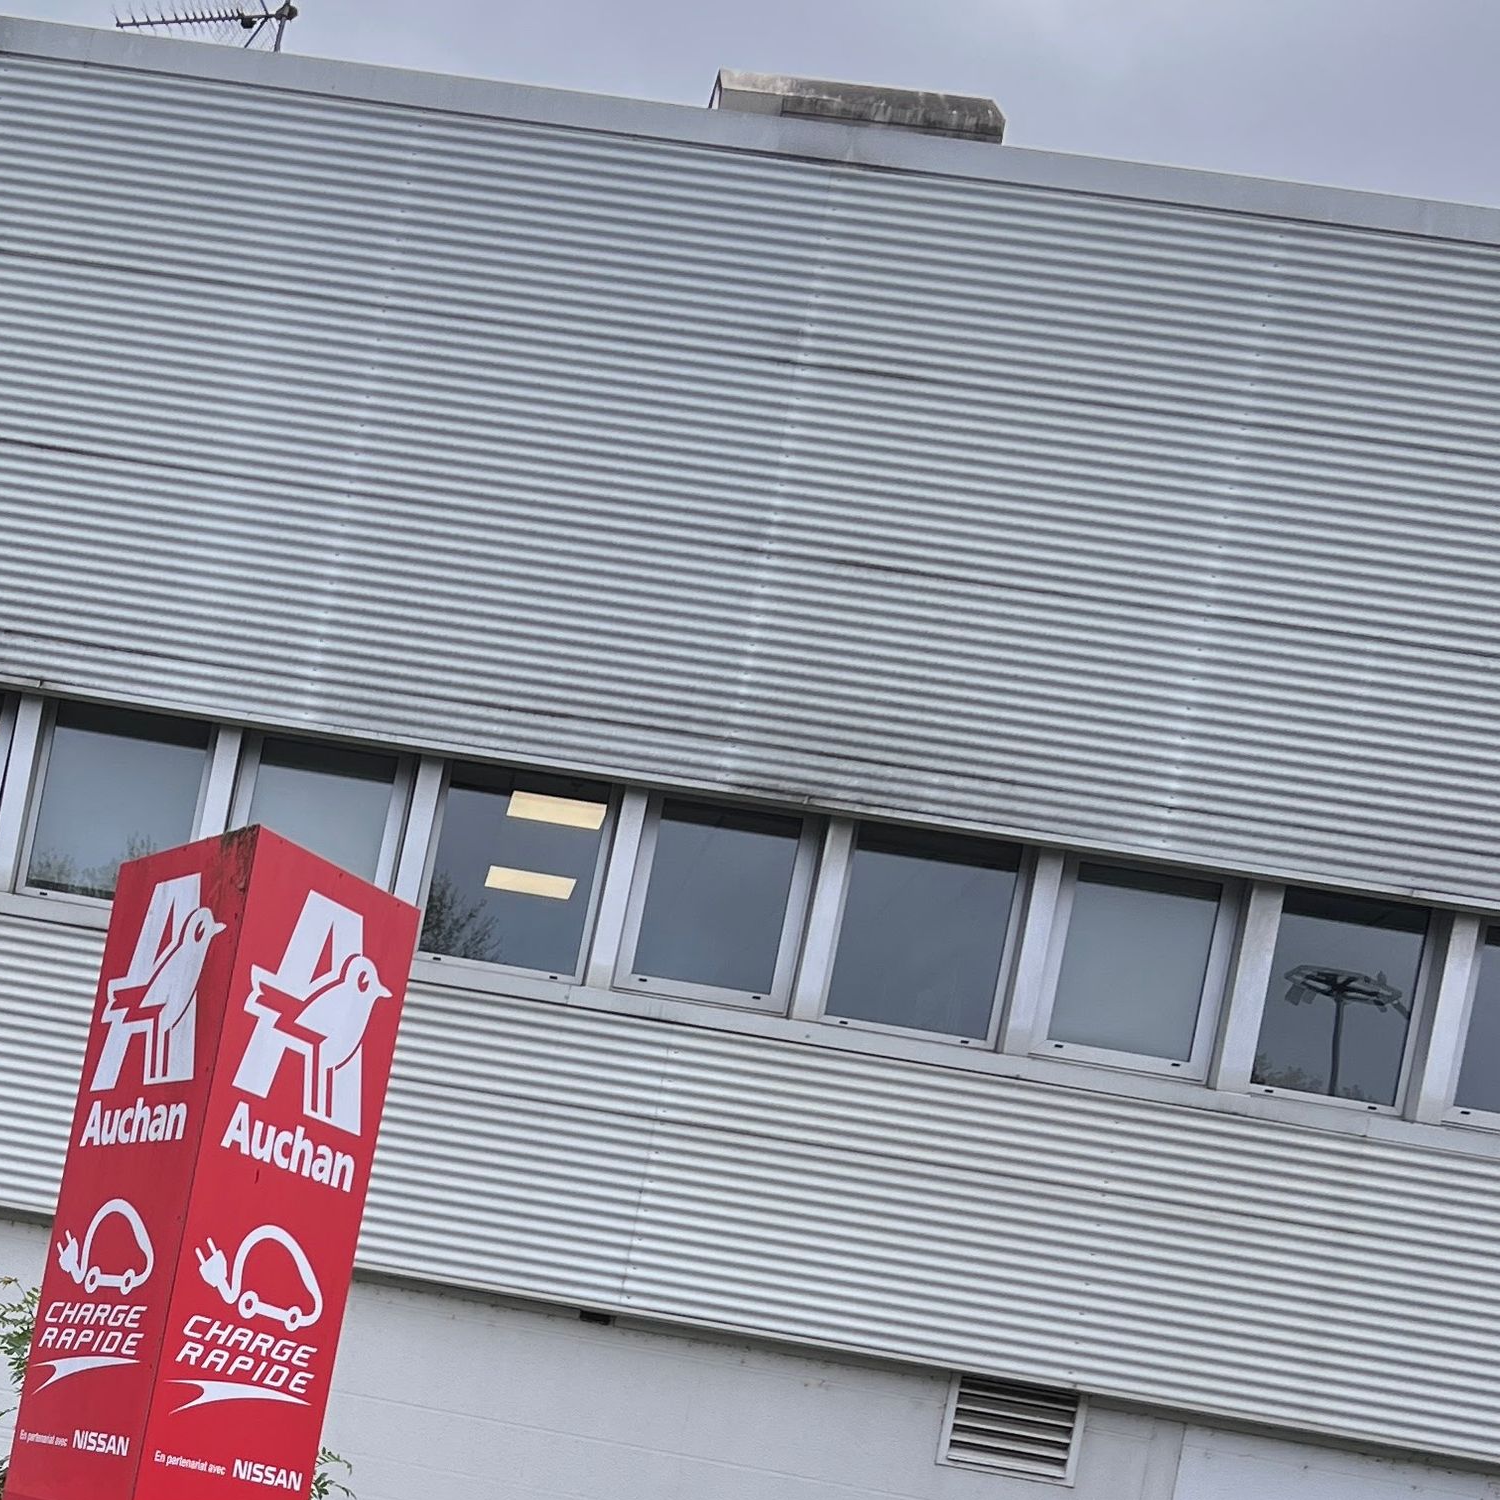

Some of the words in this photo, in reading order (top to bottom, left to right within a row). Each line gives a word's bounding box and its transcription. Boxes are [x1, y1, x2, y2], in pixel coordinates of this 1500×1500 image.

[79, 1097, 187, 1147] Auchan
[220, 1101, 355, 1193] Auchan
[44, 1301, 148, 1328] CHARGE
[38, 1326, 144, 1355] RAPIDE
[182, 1314, 318, 1368] CHARGE
[174, 1341, 315, 1394] RAPIDE
[72, 1429, 130, 1457] NISSAN
[153, 1450, 165, 1463] En
[165, 1455, 208, 1473] partenariat
[207, 1462, 227, 1476] avec
[232, 1458, 302, 1492] NISSAN
